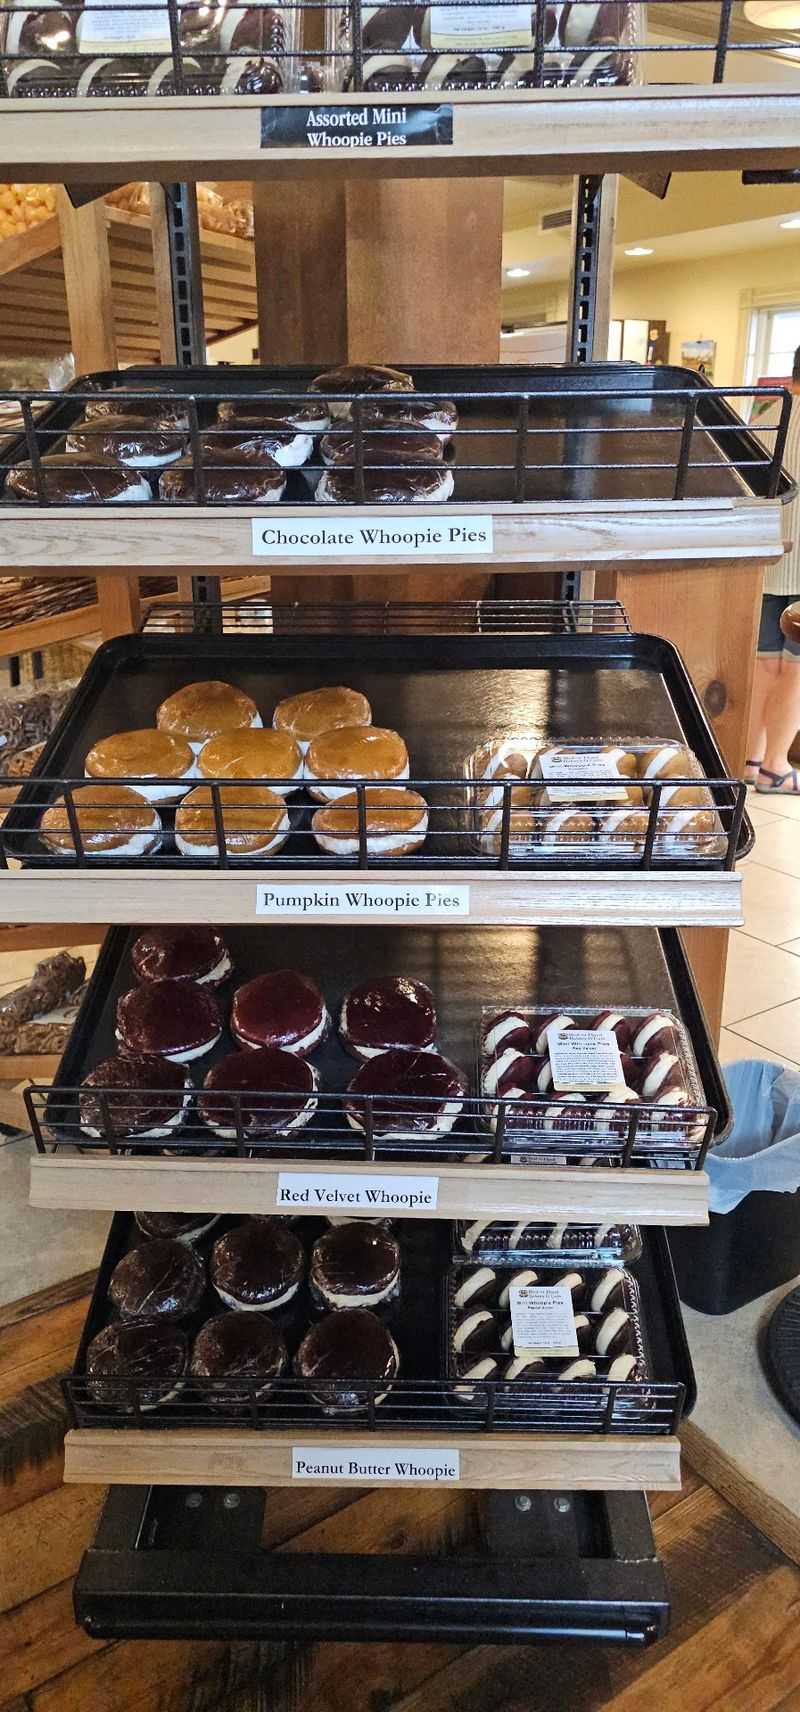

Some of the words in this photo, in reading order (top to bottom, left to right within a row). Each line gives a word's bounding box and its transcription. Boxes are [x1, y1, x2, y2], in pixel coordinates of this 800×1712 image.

[306, 108, 368, 127] Assorted
[373, 108, 407, 125] Mini
[306, 132, 372, 147] Whoopie
[377, 131, 407, 146] Pies
[261, 529, 354, 545] Chocolate
[360, 528, 443, 548] Whoopie
[449, 527, 487, 542] Pies
[264, 892, 340, 911] Pumpkin
[345, 892, 420, 911] Whoopie
[425, 893, 460, 907] Pies
[280, 1188, 309, 1202] Red
[313, 1188, 360, 1203] Velvet
[365, 1189, 432, 1208] Whoopie
[296, 1460, 343, 1474] Peanut
[349, 1461, 391, 1475] Butter
[395, 1462, 456, 1480] Whoopie
